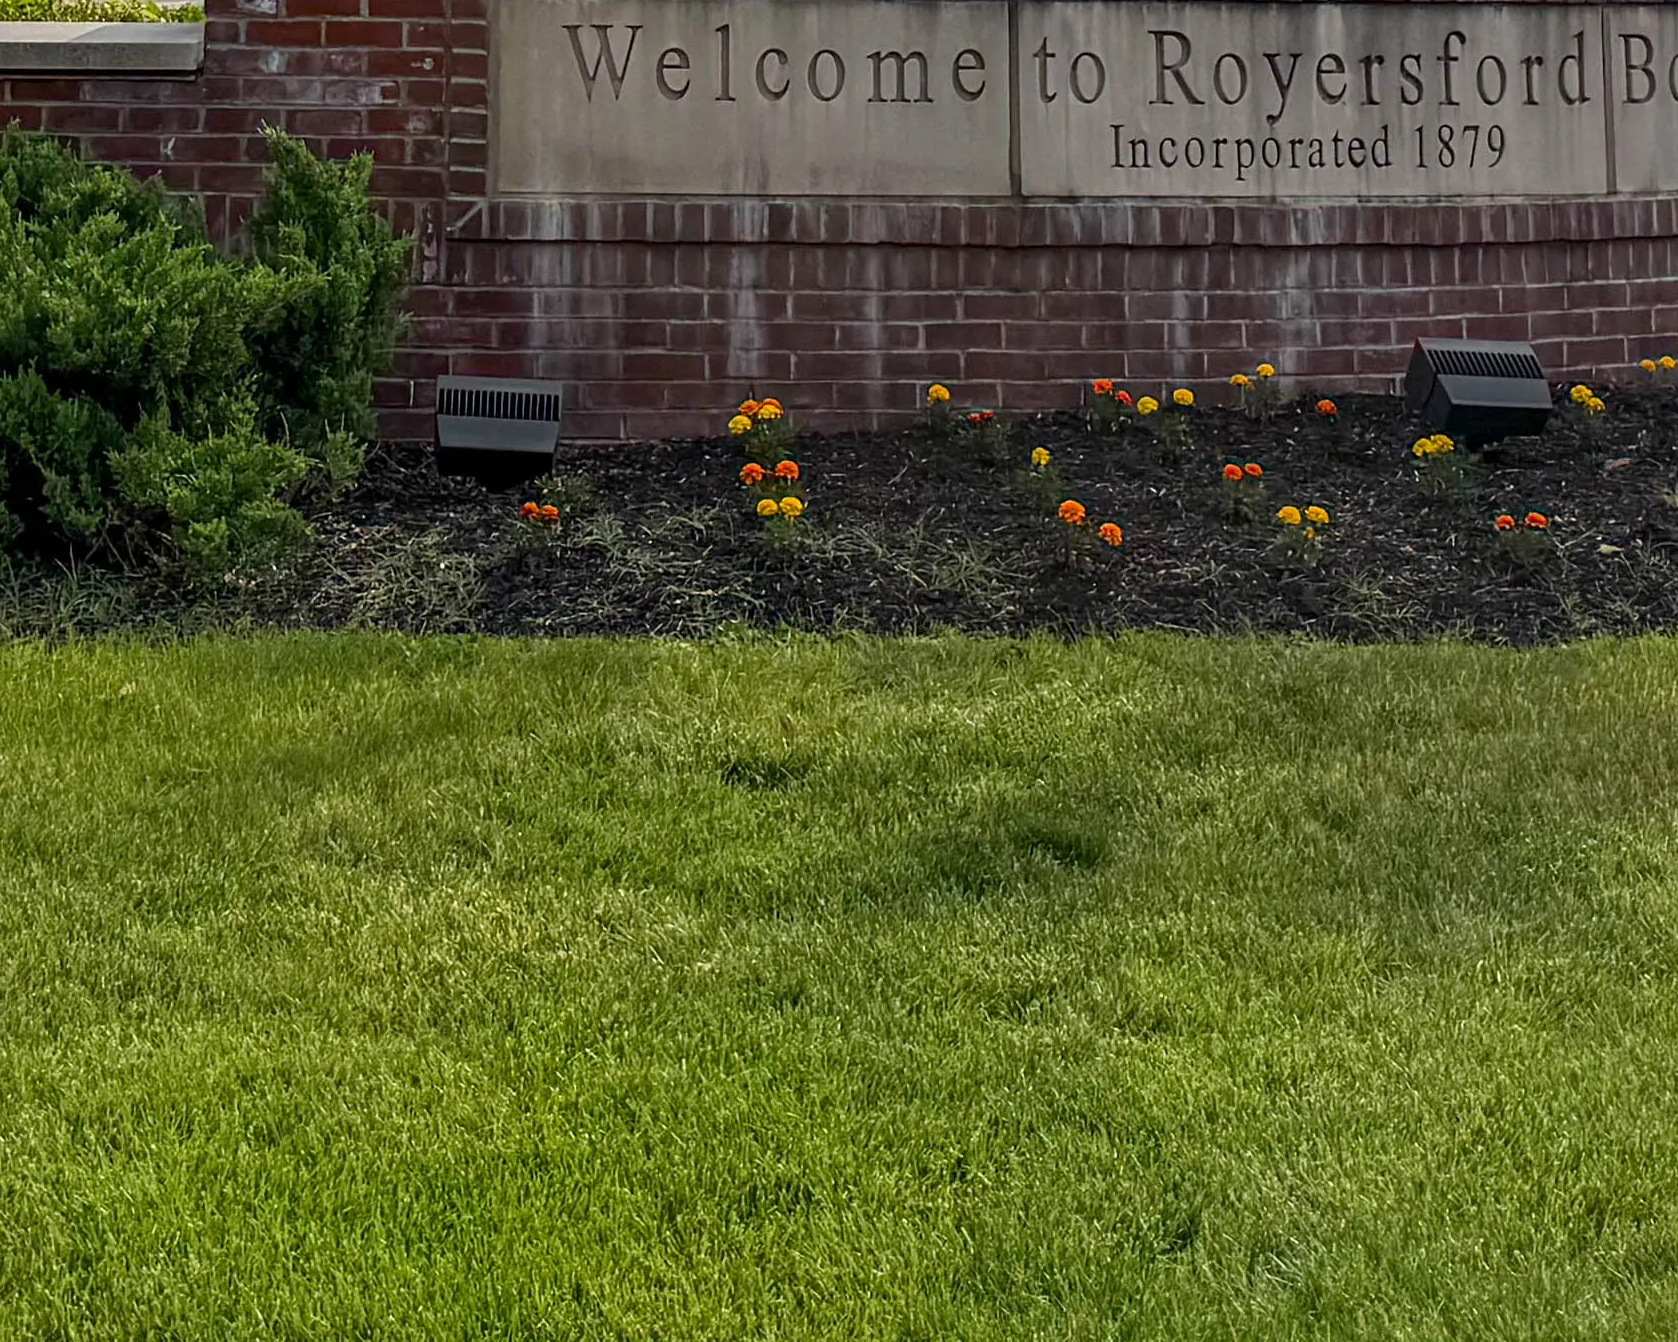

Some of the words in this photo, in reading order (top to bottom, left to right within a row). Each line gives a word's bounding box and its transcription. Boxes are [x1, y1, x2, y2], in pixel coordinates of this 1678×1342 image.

[561, 22, 987, 103] Welcome
[1032, 35, 1107, 104] to
[1146, 28, 1592, 125] Royersford
[1110, 123, 1394, 182] Incorporated
[1414, 123, 1507, 169] 1879
